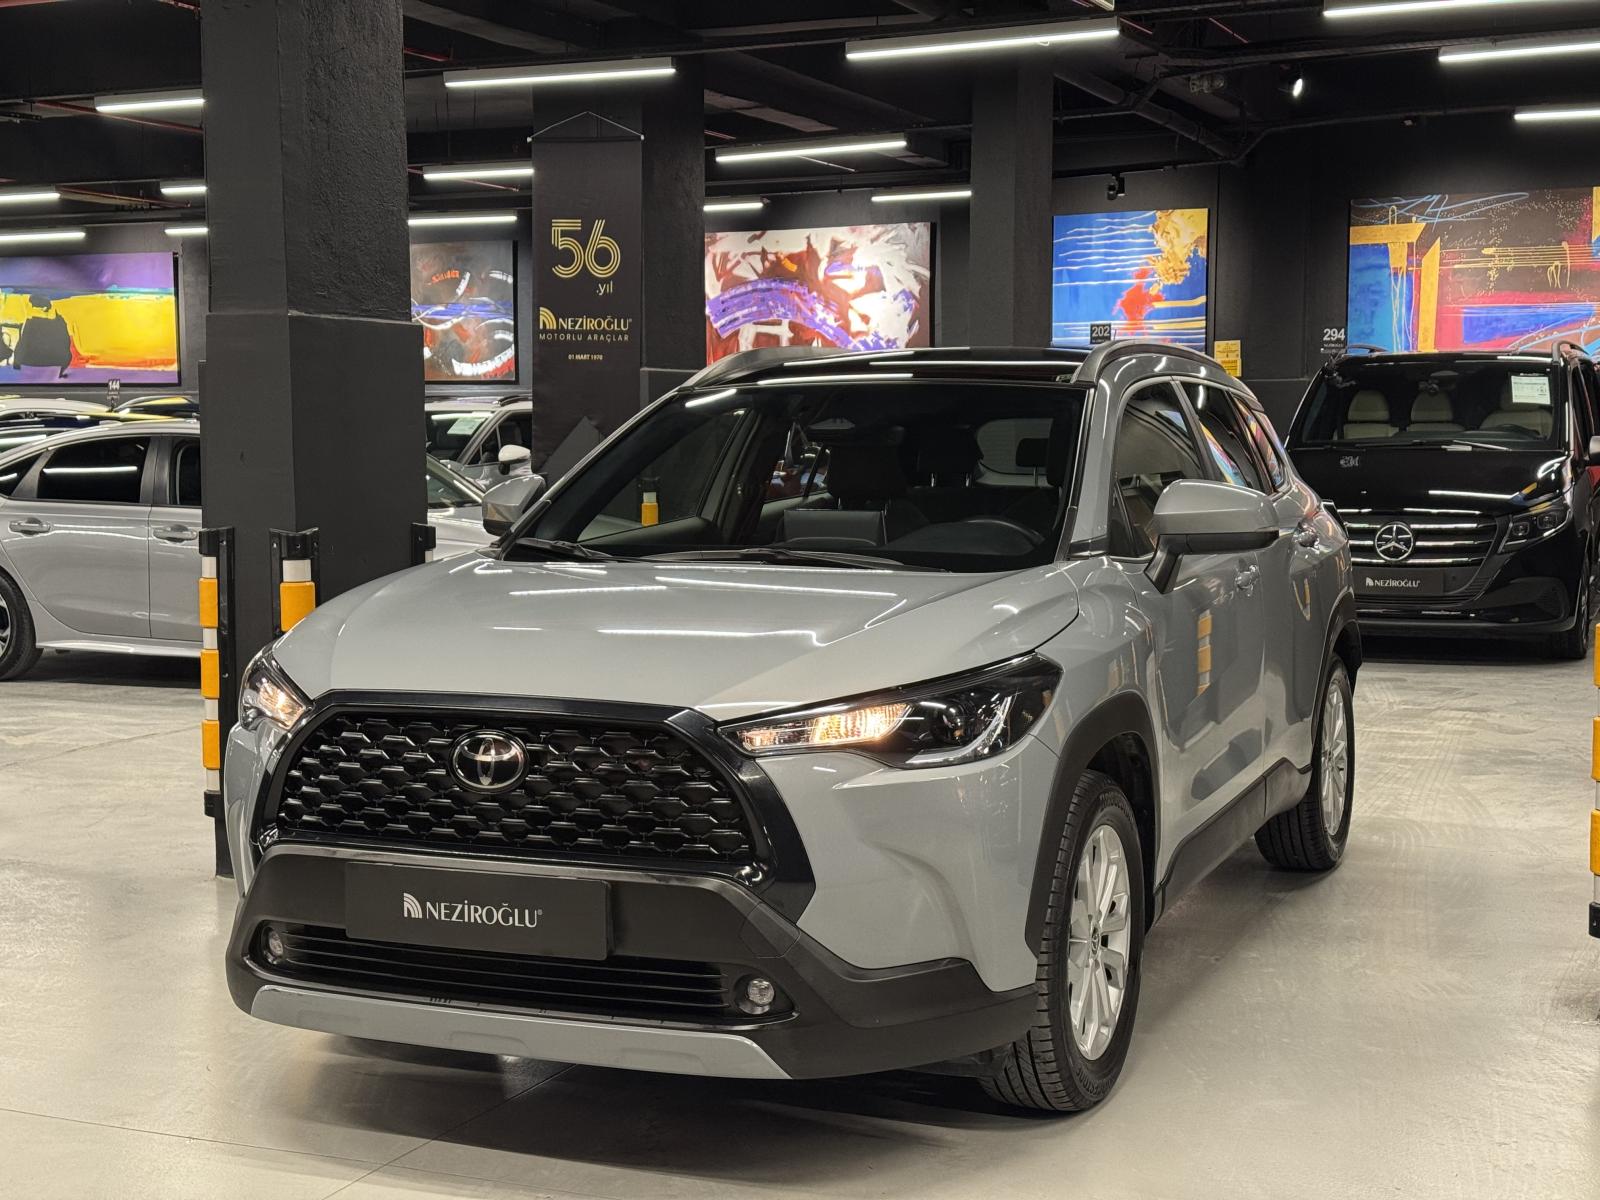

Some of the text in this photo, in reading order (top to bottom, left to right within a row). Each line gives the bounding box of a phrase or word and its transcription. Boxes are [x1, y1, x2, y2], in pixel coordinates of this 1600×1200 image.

[551, 218, 621, 278] 56
[558, 315, 629, 331] NEZİROĞLU
[539, 333, 630, 342] MOTORLU ARAÇLAR
[1092, 325, 1110, 337] 202
[1322, 327, 1345, 341] 294
[109, 379, 120, 390] 144
[1374, 578, 1419, 588] NEZİROĞLU
[426, 899, 538, 928] NEZİROĞLU
